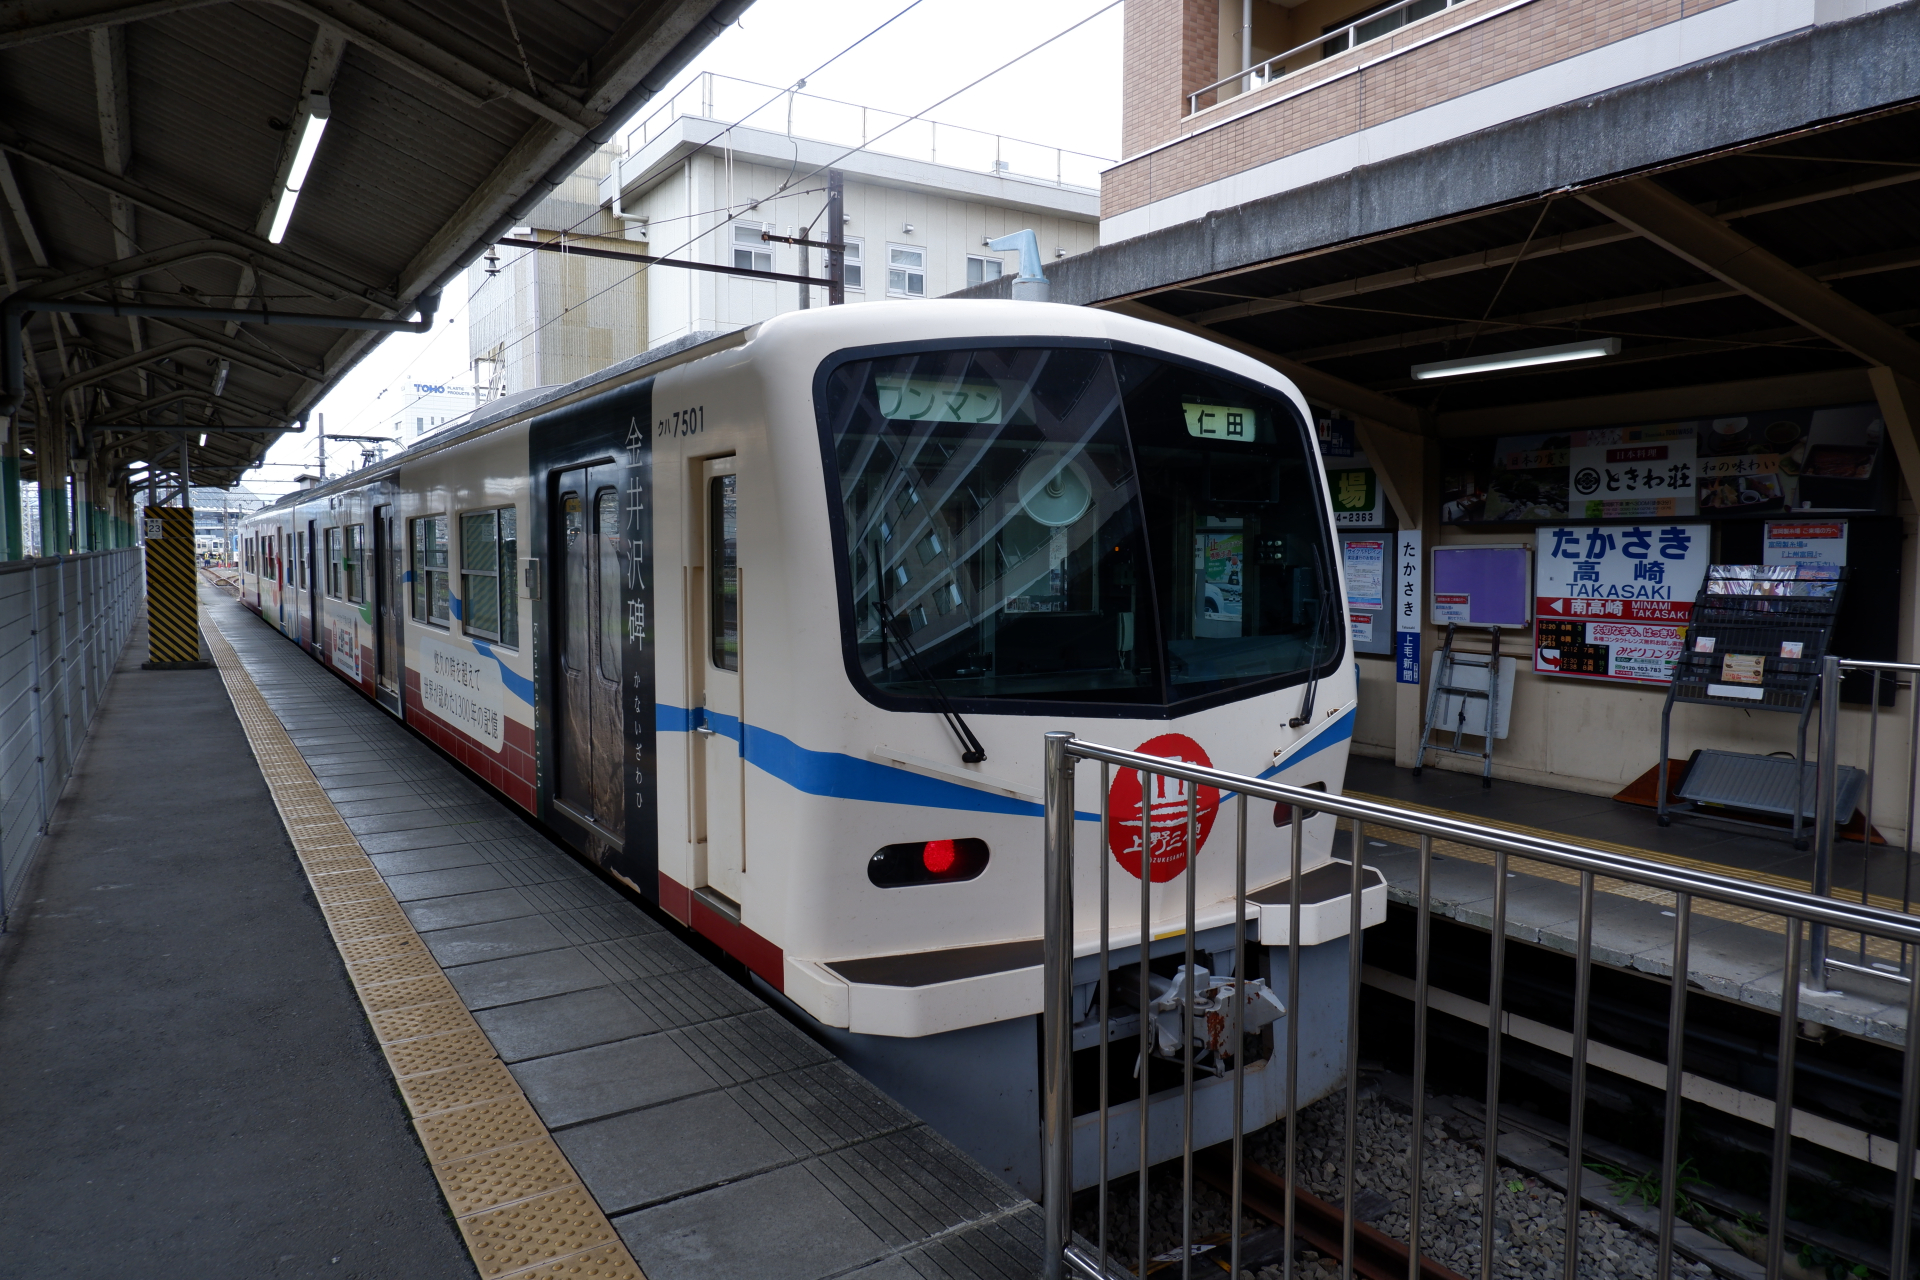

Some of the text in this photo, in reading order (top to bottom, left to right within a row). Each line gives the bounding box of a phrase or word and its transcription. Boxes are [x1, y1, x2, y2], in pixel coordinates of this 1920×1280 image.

[414, 384, 446, 394] TOHO
[876, 386, 1001, 422] ワンマン
[673, 405, 704, 438] 7501
[1183, 408, 1243, 437] 仁田
[1511, 451, 1568, 467] 日本の寛ぎ
[1616, 448, 1658, 461] 日本料理
[1605, 463, 1692, 491] ときわ荘
[1702, 461, 1776, 475] 和の味わい
[149, 525, 161, 533] 23
[625, 416, 647, 651] 金井沢碑
[1551, 527, 1692, 560] たかさき
[1403, 541, 1416, 617] たかさき
[1572, 560, 1665, 585] 高崎
[1566, 583, 1671, 600] TAKASAKI
[1570, 599, 1624, 618] 南高崎
[1631, 601, 1672, 611] MINAMI
[1631, 609, 1690, 620] TAKASAKI
[1539, 623, 1557, 631] 12:20
[1403, 634, 1414, 682] 上毛新聞
[1621, 665, 1662, 673] 0120-103-783
[634, 671, 643, 809] かないざわひ
